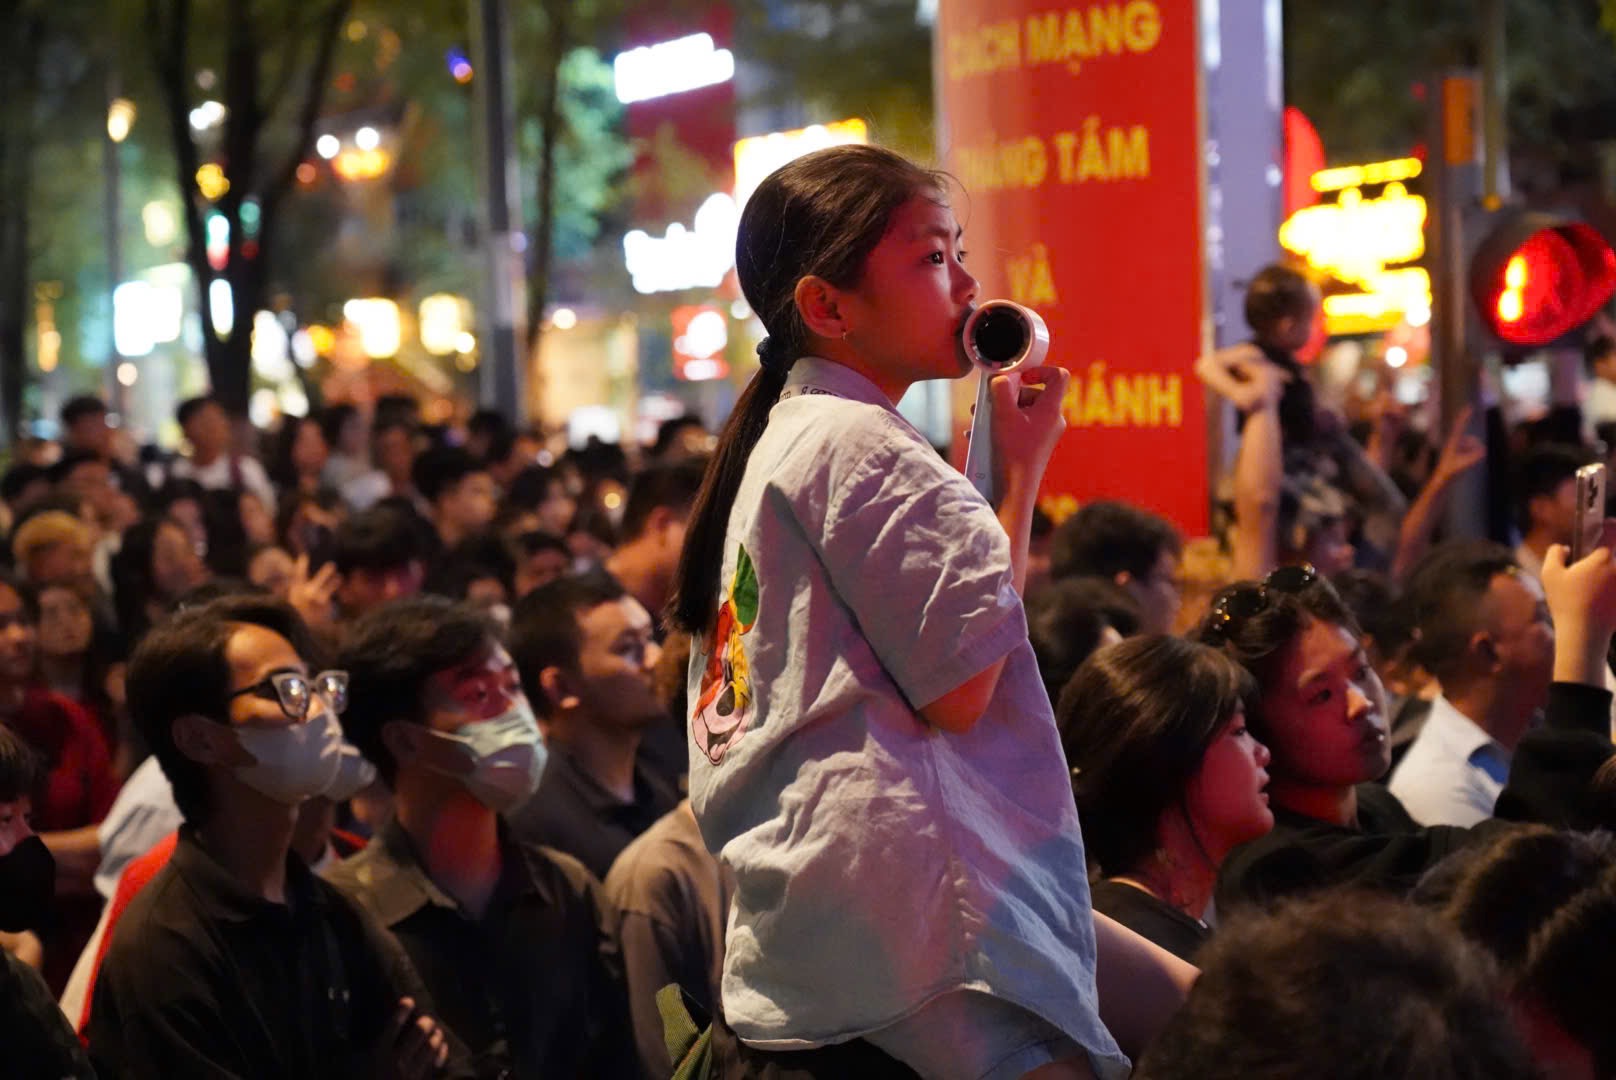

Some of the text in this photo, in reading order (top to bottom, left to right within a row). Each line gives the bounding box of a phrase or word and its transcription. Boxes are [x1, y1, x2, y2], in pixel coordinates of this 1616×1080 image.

[1027, 2, 1161, 75] MẠNG
[1055, 116, 1150, 183] TÁM
[1062, 361, 1183, 427] HÁNH
